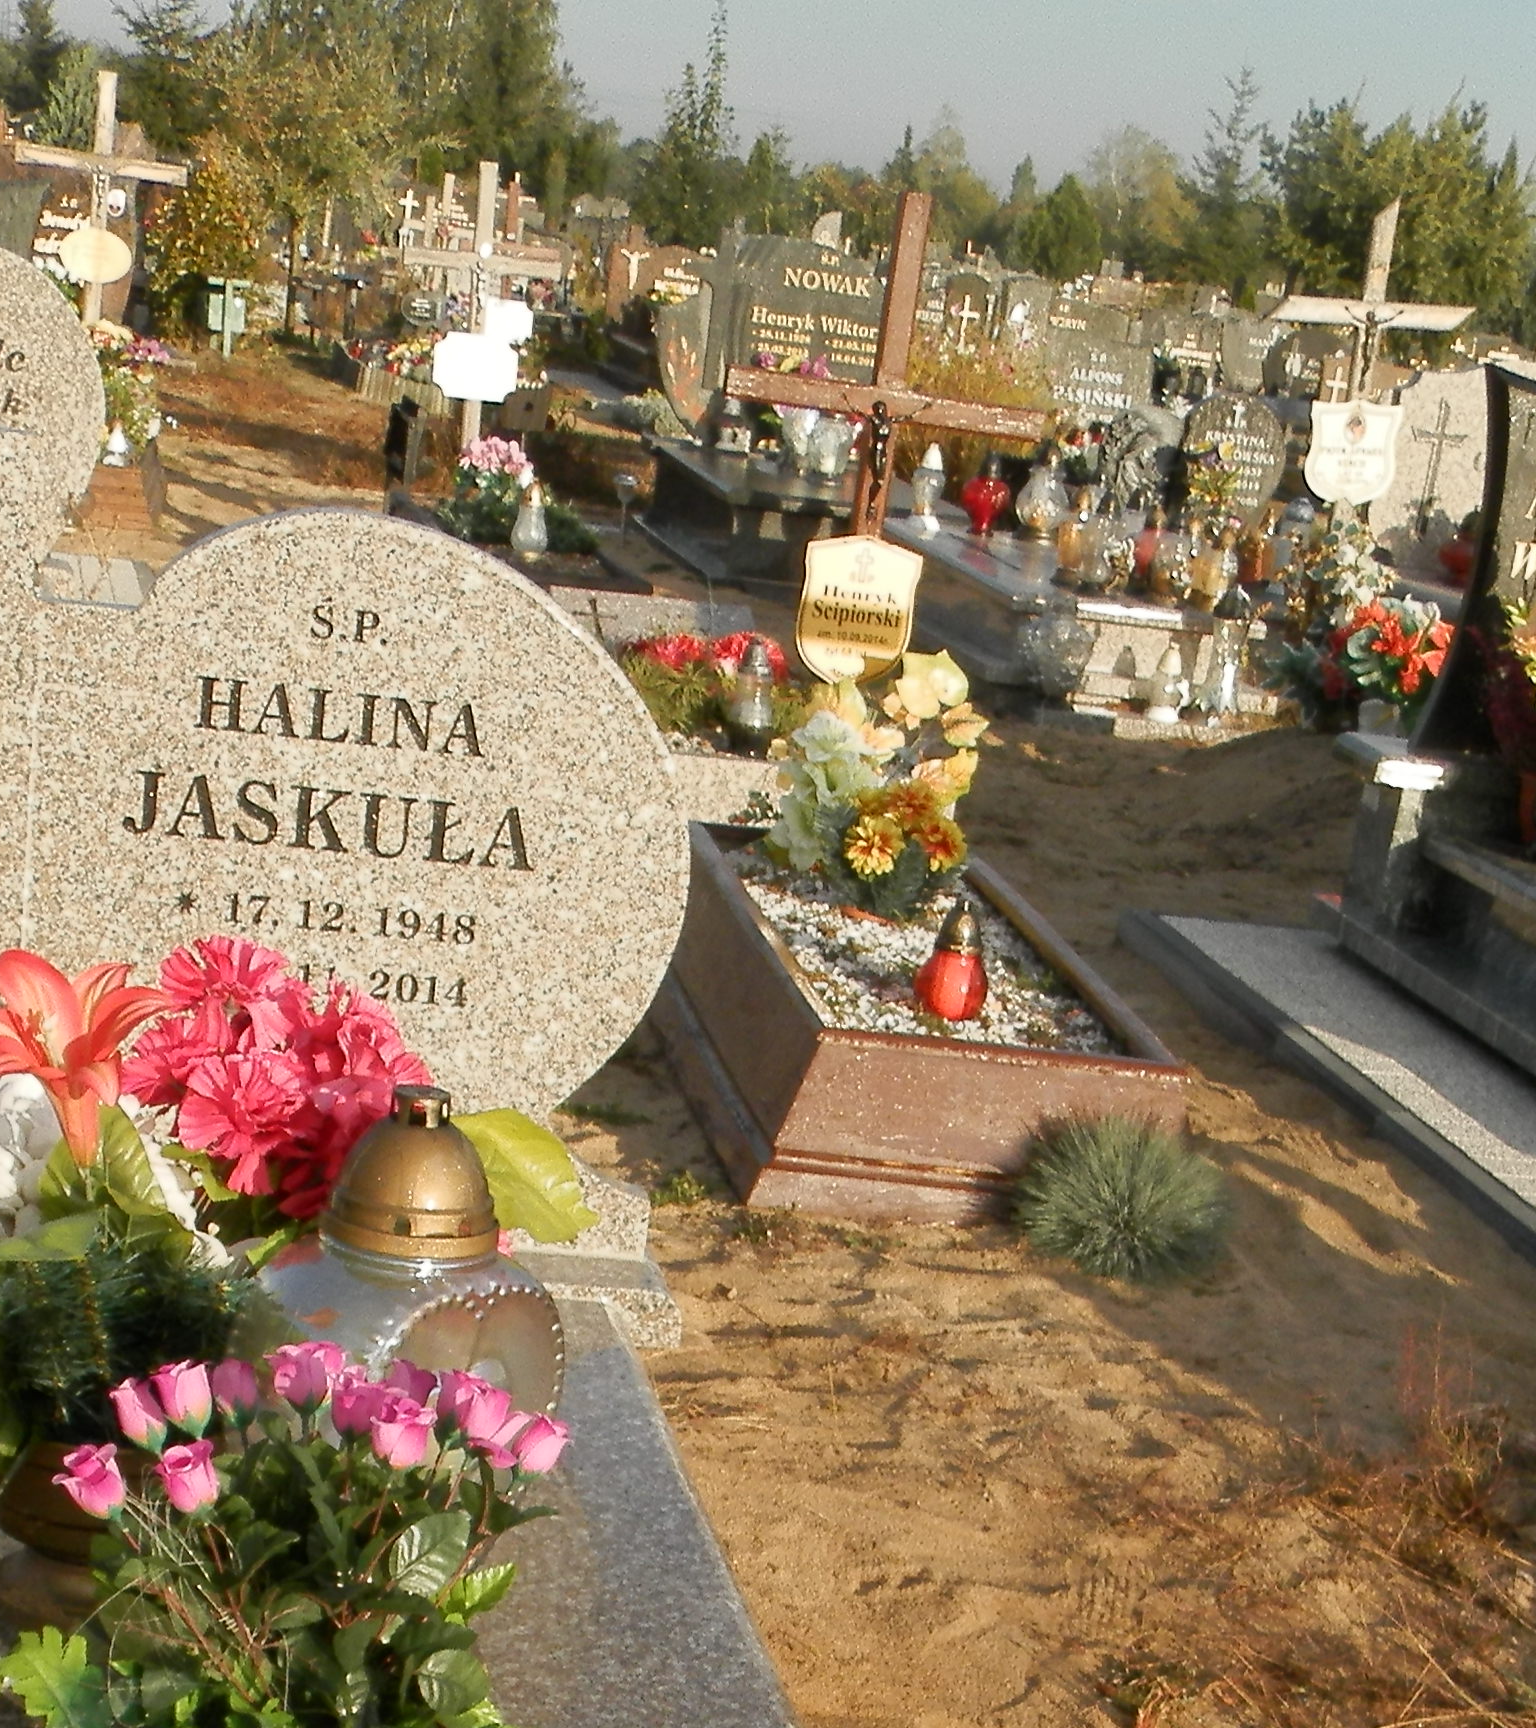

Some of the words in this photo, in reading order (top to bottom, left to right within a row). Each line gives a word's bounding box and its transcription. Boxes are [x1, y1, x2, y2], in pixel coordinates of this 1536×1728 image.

[784, 267, 870, 299] NOWAK
[751, 306, 815, 332] Henryk
[821, 315, 879, 339] Wiktor
[1233, 449, 1275, 466] OWSKA
[812, 599, 902, 629] Scipiorski
[824, 585, 897, 607] Henryk
[310, 597, 389, 646] Ś.P.
[193, 675, 484, 758] HALINA
[121, 769, 535, 872] JASKUŁA
[223, 893, 280, 927] 17.
[295, 899, 357, 934] 12.
[372, 906, 477, 946] 1948
[368, 965, 470, 1008] 2014
